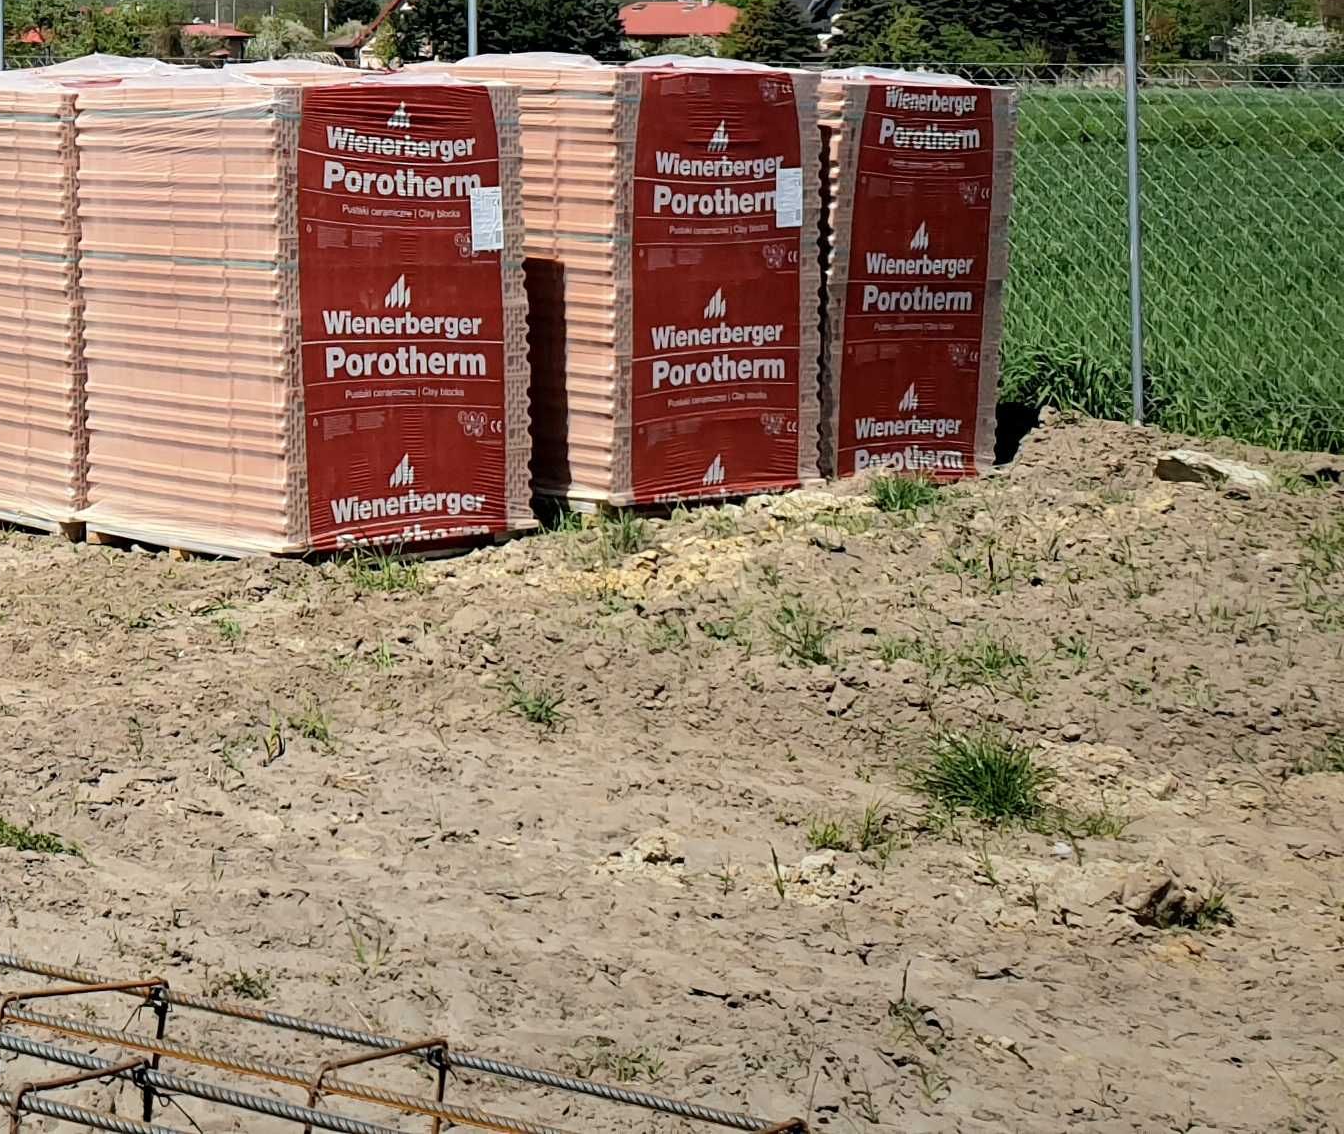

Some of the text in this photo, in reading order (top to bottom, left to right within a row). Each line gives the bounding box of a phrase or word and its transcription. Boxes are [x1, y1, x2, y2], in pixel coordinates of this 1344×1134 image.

[885, 86, 977, 116] Wienerberger
[326, 125, 476, 162] Wienerberger
[879, 118, 980, 149] Porotherm
[323, 160, 481, 197] Porotherm
[655, 151, 784, 178] Wienerberger
[866, 252, 974, 279] Wienerberger
[862, 285, 973, 312] Porotherm
[322, 310, 483, 339] Wienerberger
[651, 322, 784, 350] Wienerberger
[325, 346, 487, 378] Porotherm
[652, 354, 786, 389] Porotherm
[855, 415, 962, 440] Wienerberger
[330, 490, 486, 524] Wienerberger
